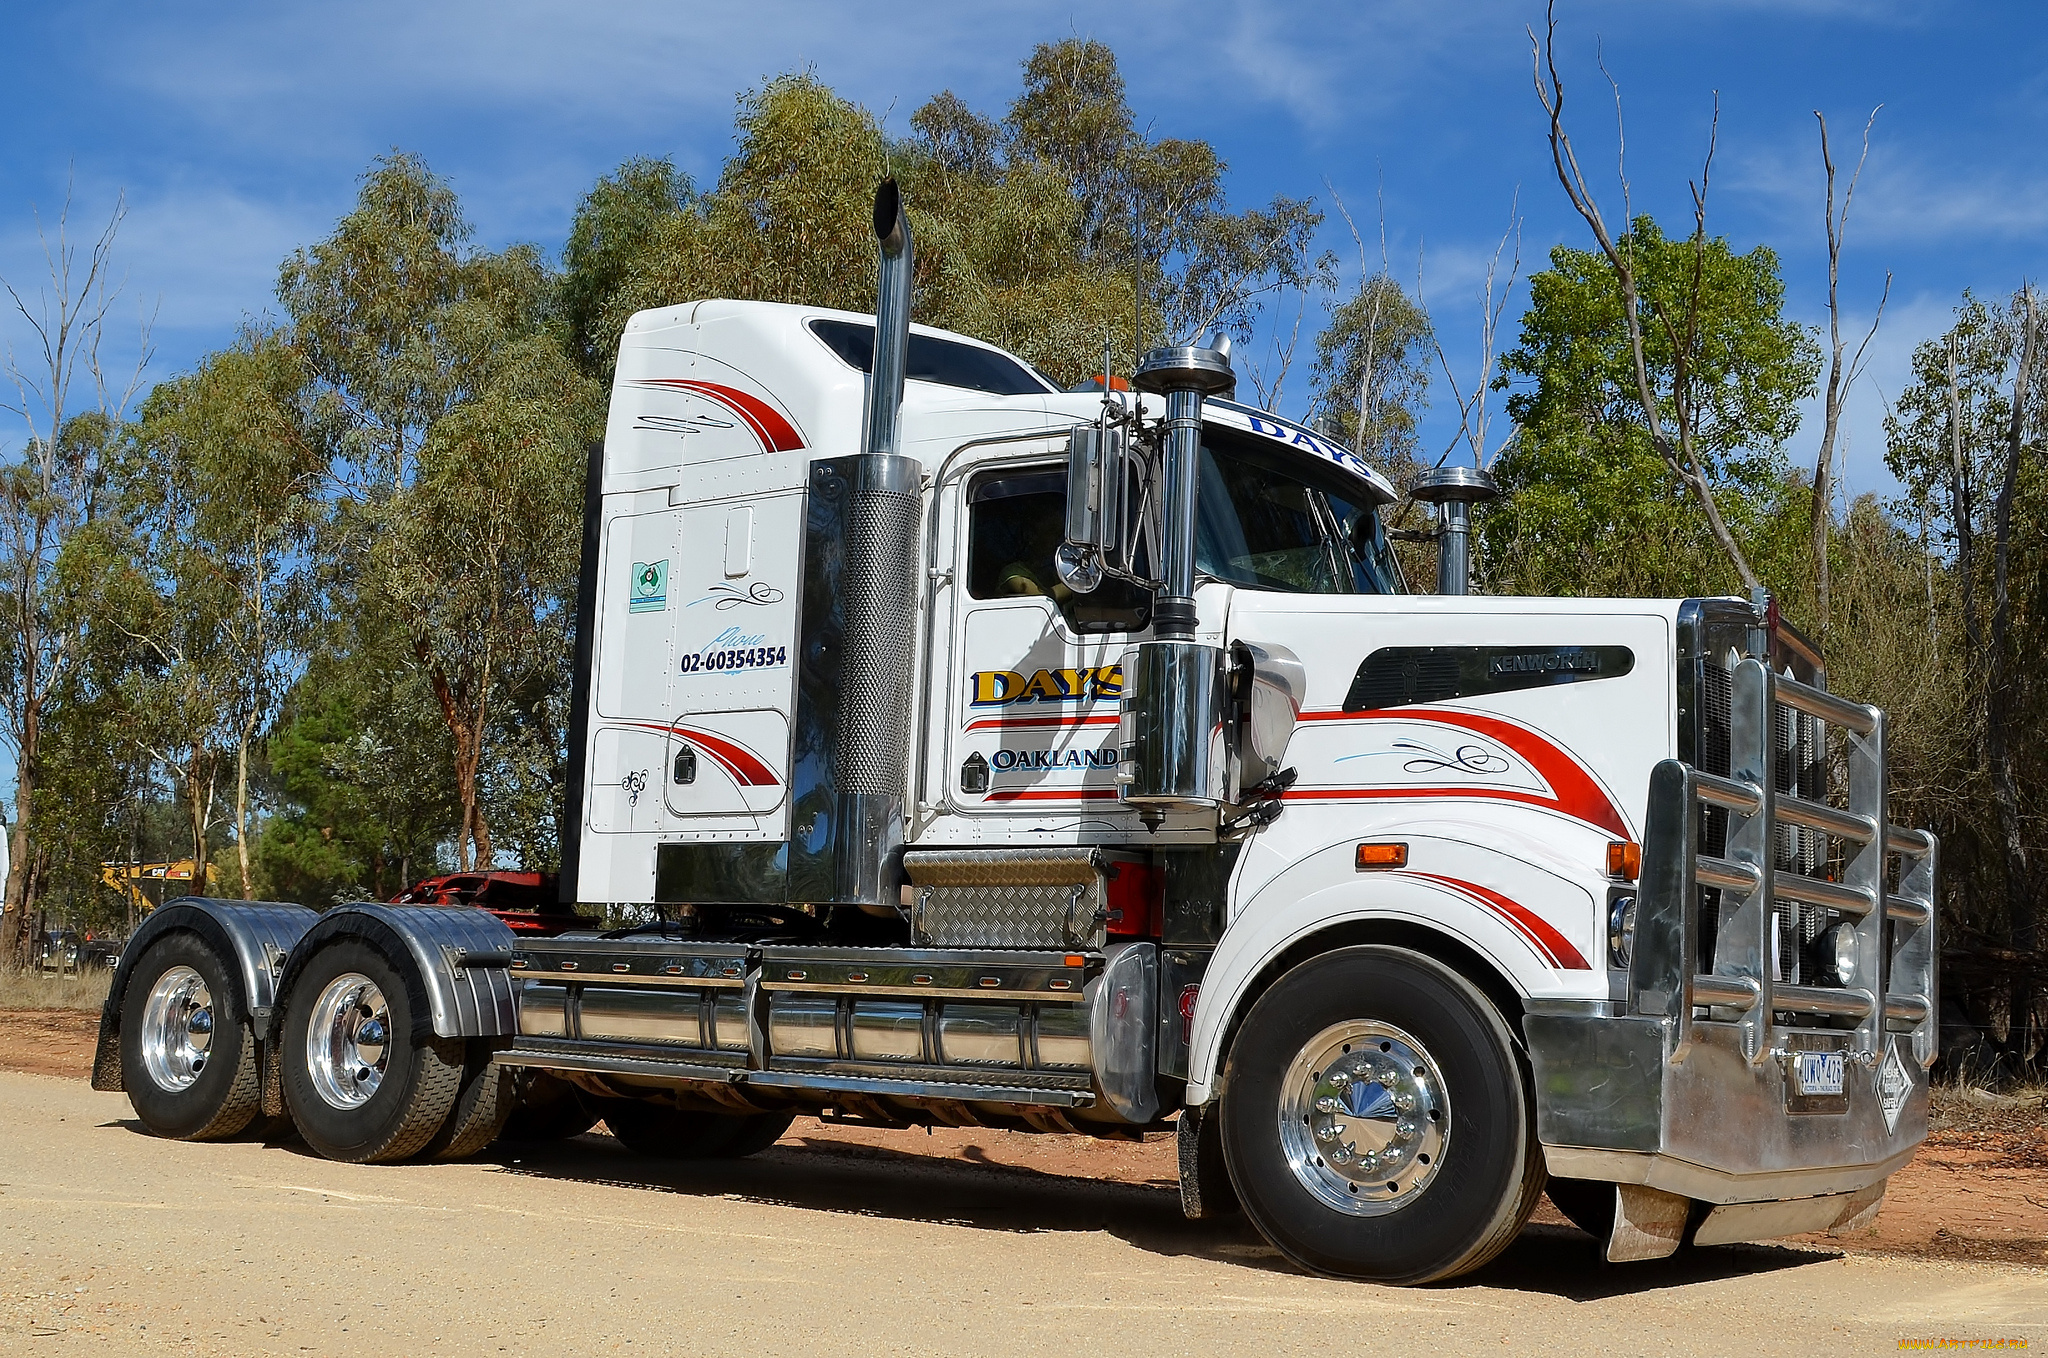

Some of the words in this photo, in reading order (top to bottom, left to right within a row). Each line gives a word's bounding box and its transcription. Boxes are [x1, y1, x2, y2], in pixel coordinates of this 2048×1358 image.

[1247, 415, 1372, 478] DAYS
[700, 626, 765, 654] Phone
[681, 646, 787, 673] 02-60354354
[1489, 651, 1597, 673] KENWORTH
[969, 664, 1122, 708] DAYS
[152, 868, 165, 877] CAT
[1804, 1058, 1821, 1082] UWQ
